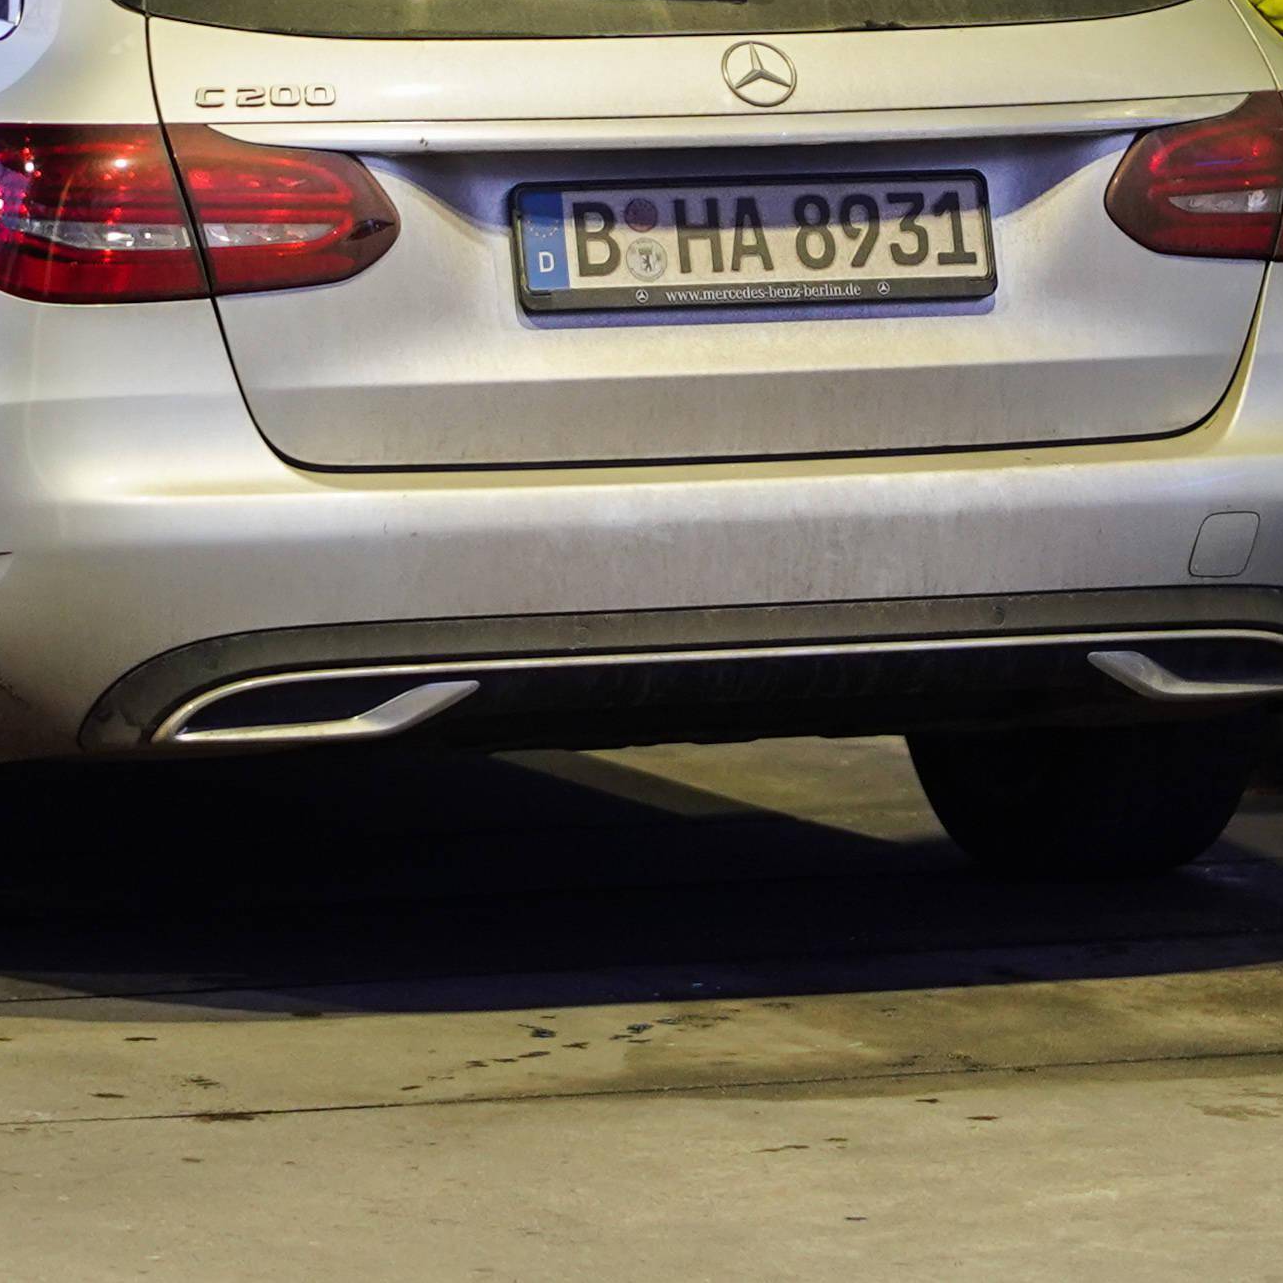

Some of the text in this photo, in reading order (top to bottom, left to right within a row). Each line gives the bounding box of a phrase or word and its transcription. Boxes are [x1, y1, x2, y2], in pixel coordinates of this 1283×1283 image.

[195, 83, 336, 108] C 200
[573, 190, 977, 277] B HA 8931
[538, 251, 555, 273] D
[665, 283, 862, 302] www.mercedes-benz-berlin.de
